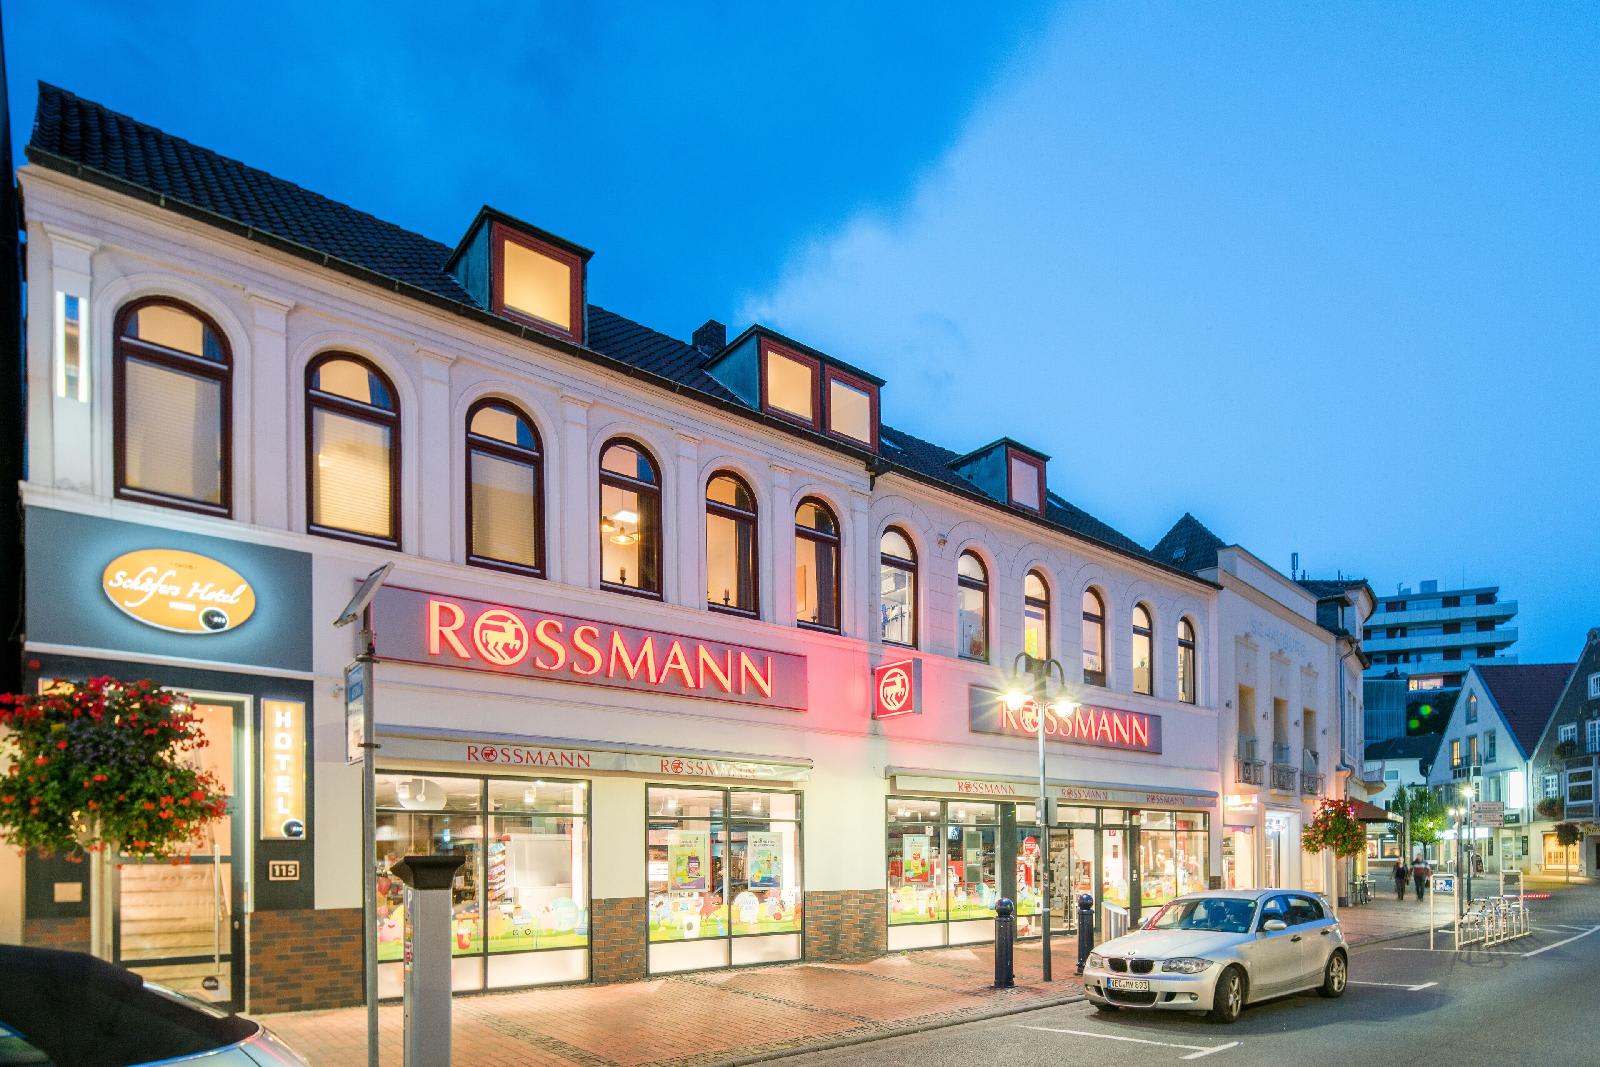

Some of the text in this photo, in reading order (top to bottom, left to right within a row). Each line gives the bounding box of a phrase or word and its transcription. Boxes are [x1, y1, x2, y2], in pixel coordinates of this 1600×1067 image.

[428, 599, 773, 698] ROSSMANN
[274, 711, 292, 814] HOTEL
[467, 745, 591, 767] ROSSMANN
[957, 781, 1016, 795] ROSSMANN
[1061, 788, 1108, 801] ROSSMANN
[273, 864, 297, 877] 115
